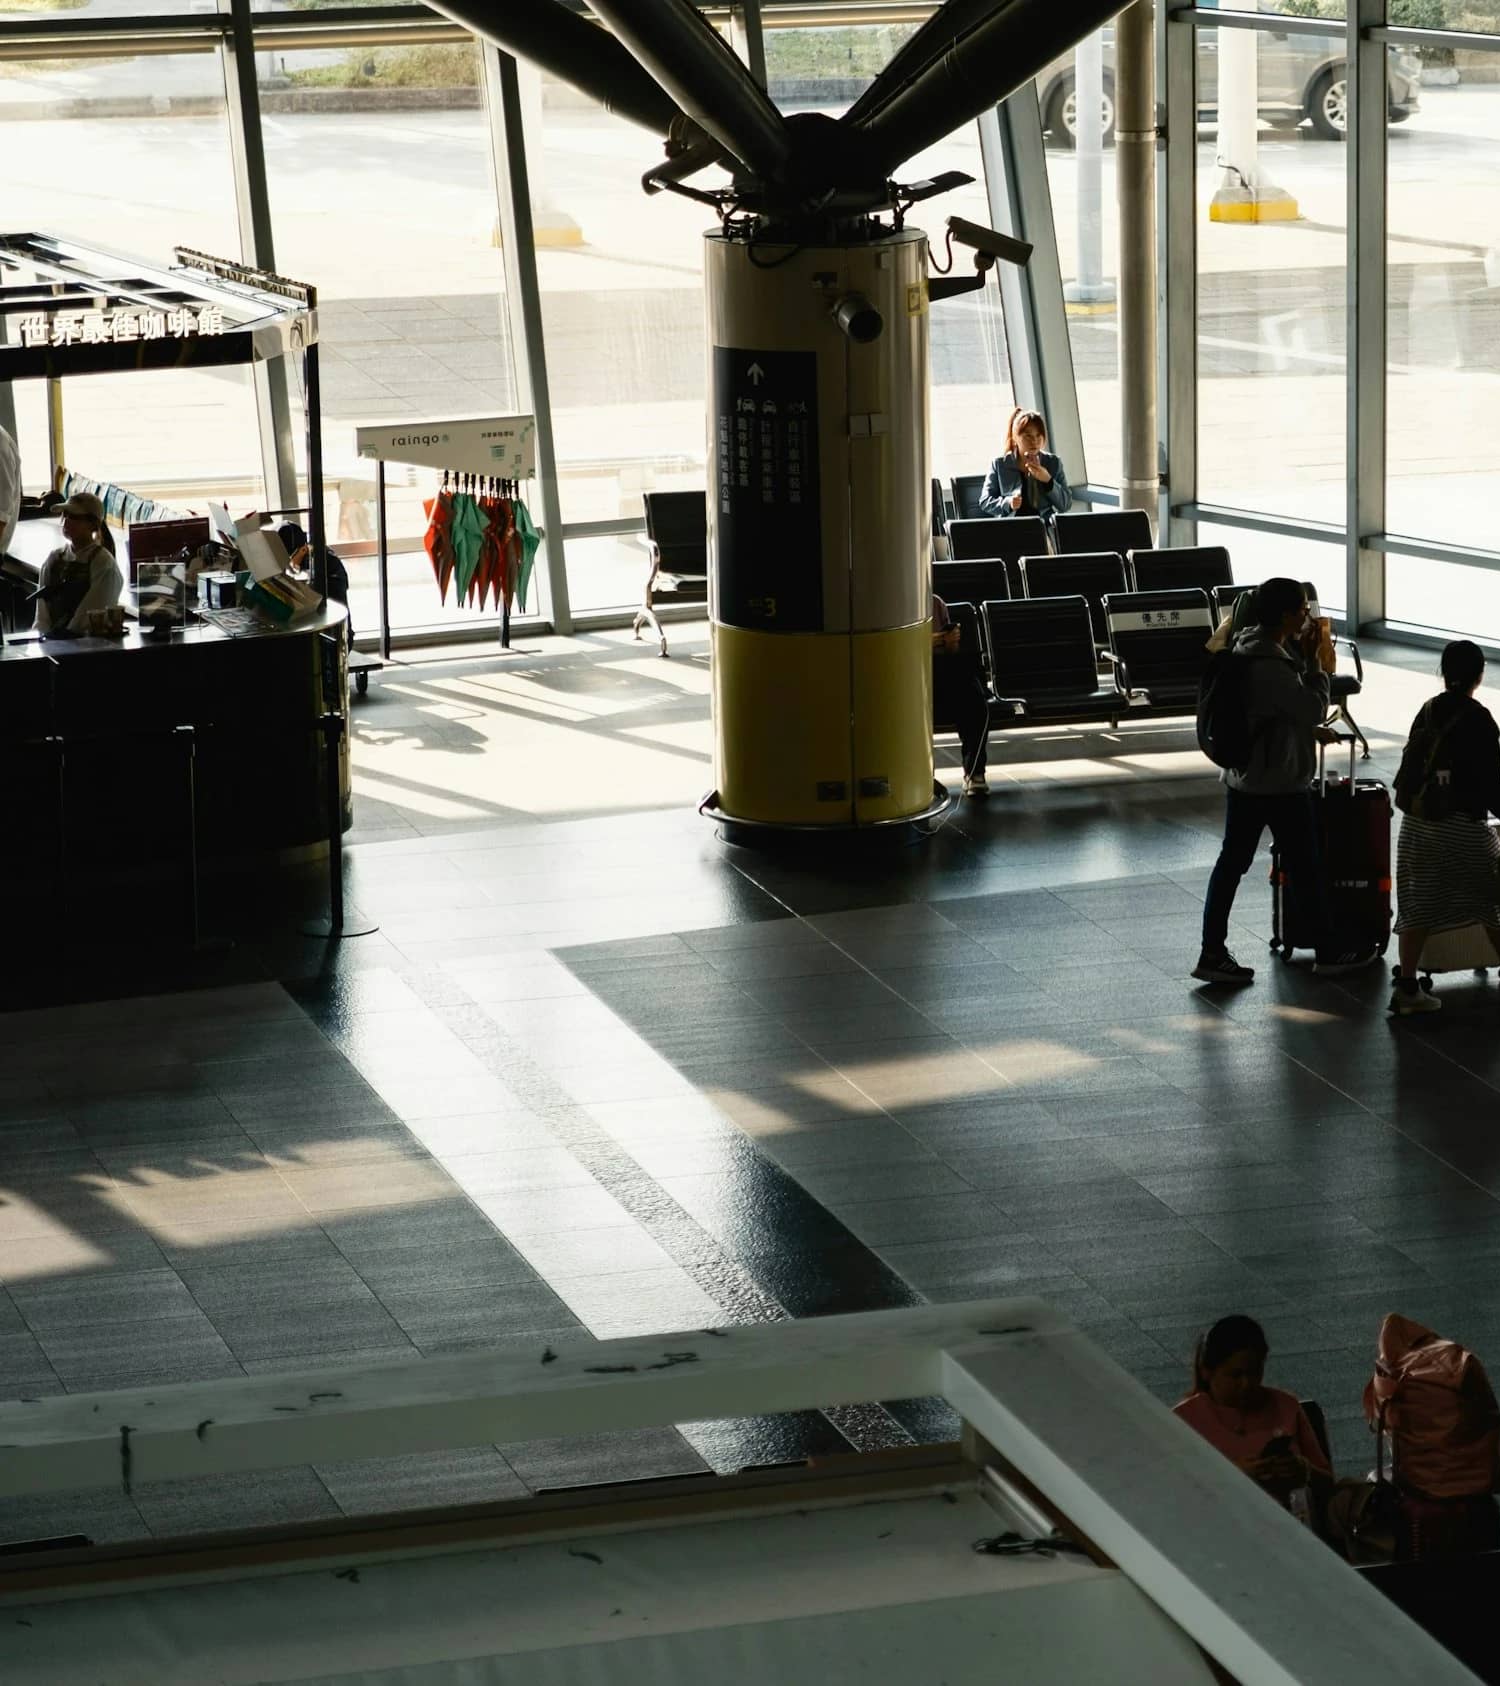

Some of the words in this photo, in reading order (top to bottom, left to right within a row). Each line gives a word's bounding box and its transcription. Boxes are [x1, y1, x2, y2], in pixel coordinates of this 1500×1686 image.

[22, 306, 225, 347] 世界最佳咖啡館
[392, 434, 439, 447] raingo
[764, 598, 777, 617] 3
